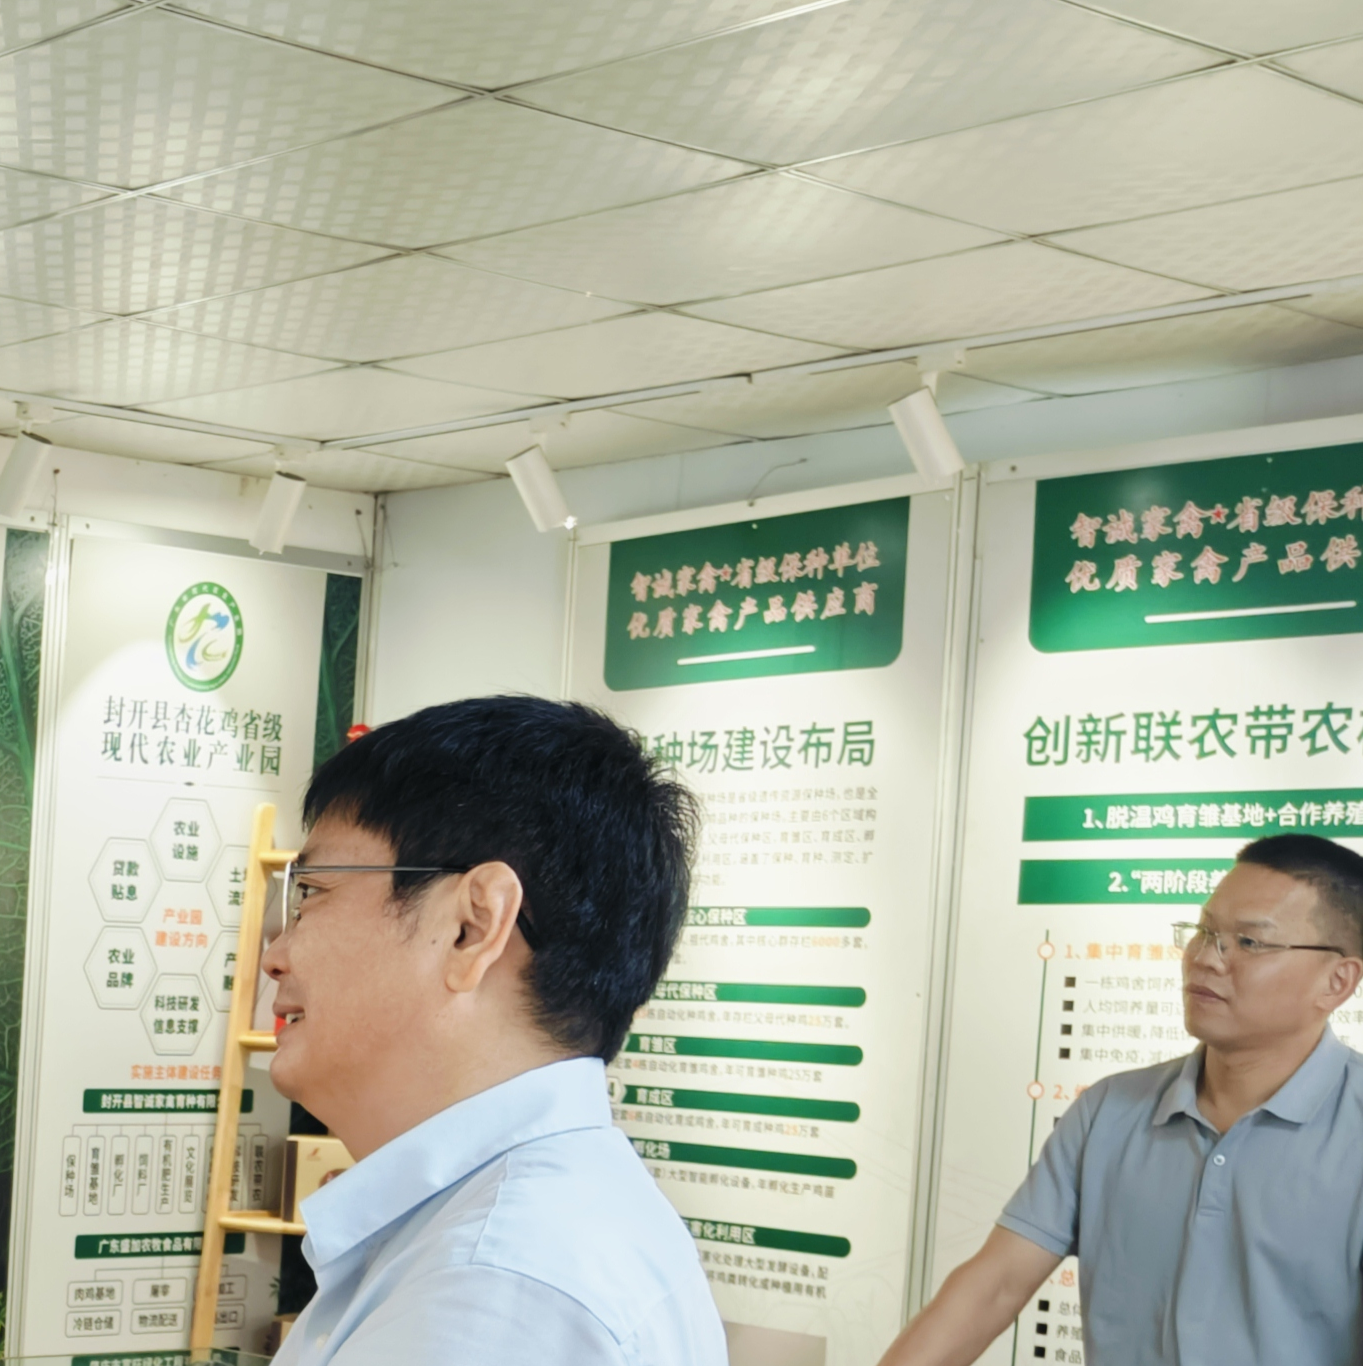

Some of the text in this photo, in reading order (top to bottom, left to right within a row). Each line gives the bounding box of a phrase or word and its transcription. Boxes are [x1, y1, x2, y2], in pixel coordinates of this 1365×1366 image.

[1066, 533, 1362, 594] 优质家禽产品供
[627, 581, 879, 640] 优质家禽产品供应商
[103, 695, 283, 743] 封开县杏花鸡省级
[1023, 701, 1364, 767] 创新联农带农
[101, 731, 282, 776] 现代农业产业园
[640, 720, 876, 774] 种场建设布局
[173, 820, 200, 838] 农业
[172, 844, 199, 862] 设施
[162, 908, 203, 926] 产业园
[154, 930, 209, 949] 建设方向
[107, 948, 135, 966] 农业
[100, 1092, 221, 1111] 封开县智诚家禽育种有限
